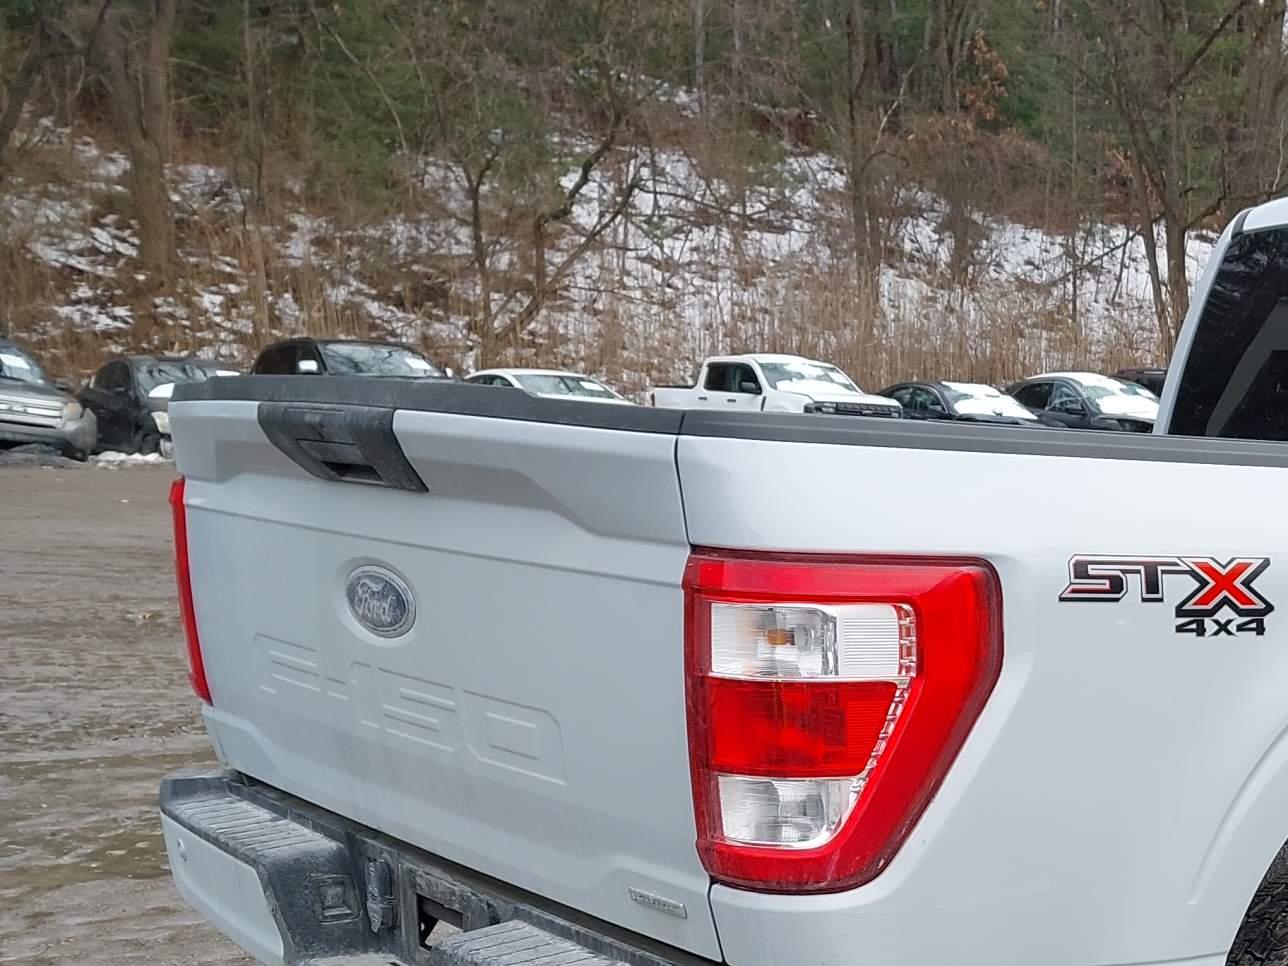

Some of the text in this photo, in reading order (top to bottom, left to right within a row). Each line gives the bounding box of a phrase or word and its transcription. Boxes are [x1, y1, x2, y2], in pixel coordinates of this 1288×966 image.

[353, 578, 398, 624] Ford
[1058, 553, 1275, 618] STX
[253, 631, 567, 787] F-150
